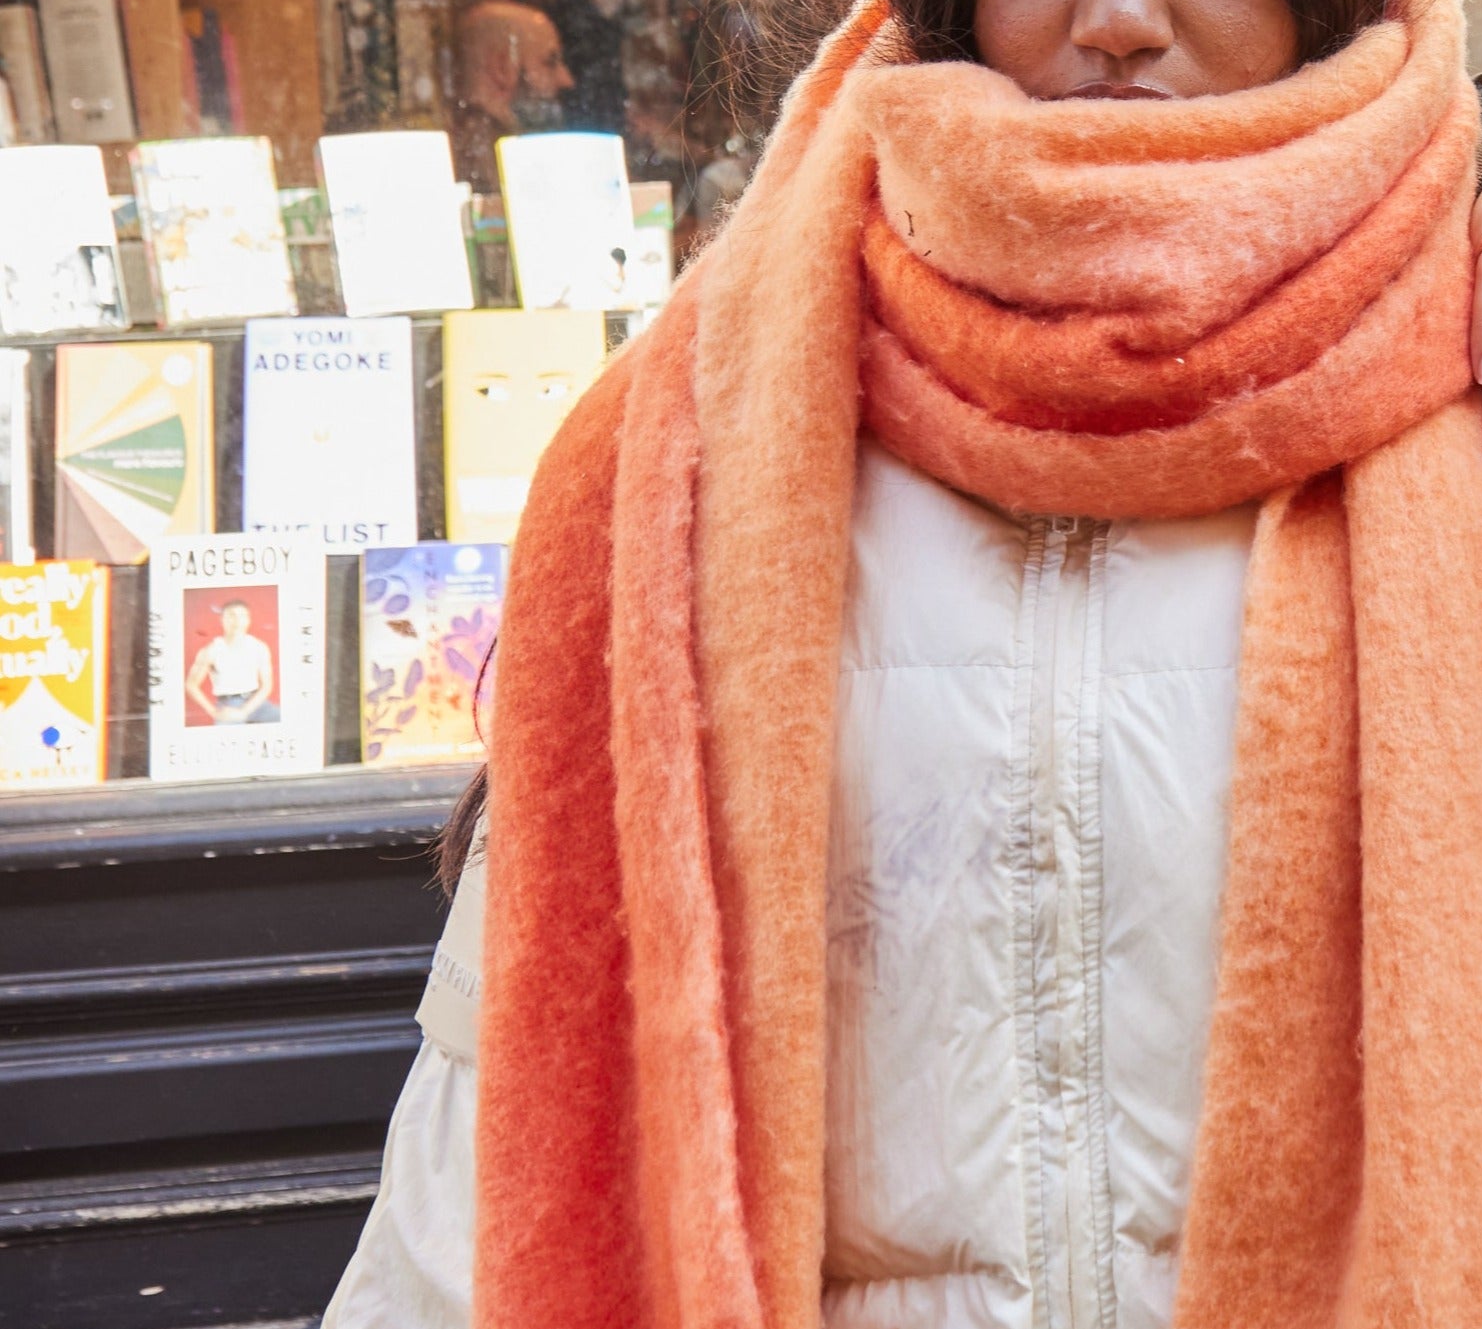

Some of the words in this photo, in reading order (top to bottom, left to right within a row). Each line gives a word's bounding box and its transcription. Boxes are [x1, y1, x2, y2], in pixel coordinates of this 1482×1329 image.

[293, 330, 352, 346] YOMI
[254, 352, 391, 371] ADEGOKE
[323, 523, 390, 544] LIST
[169, 545, 293, 577] PAGEBOY
